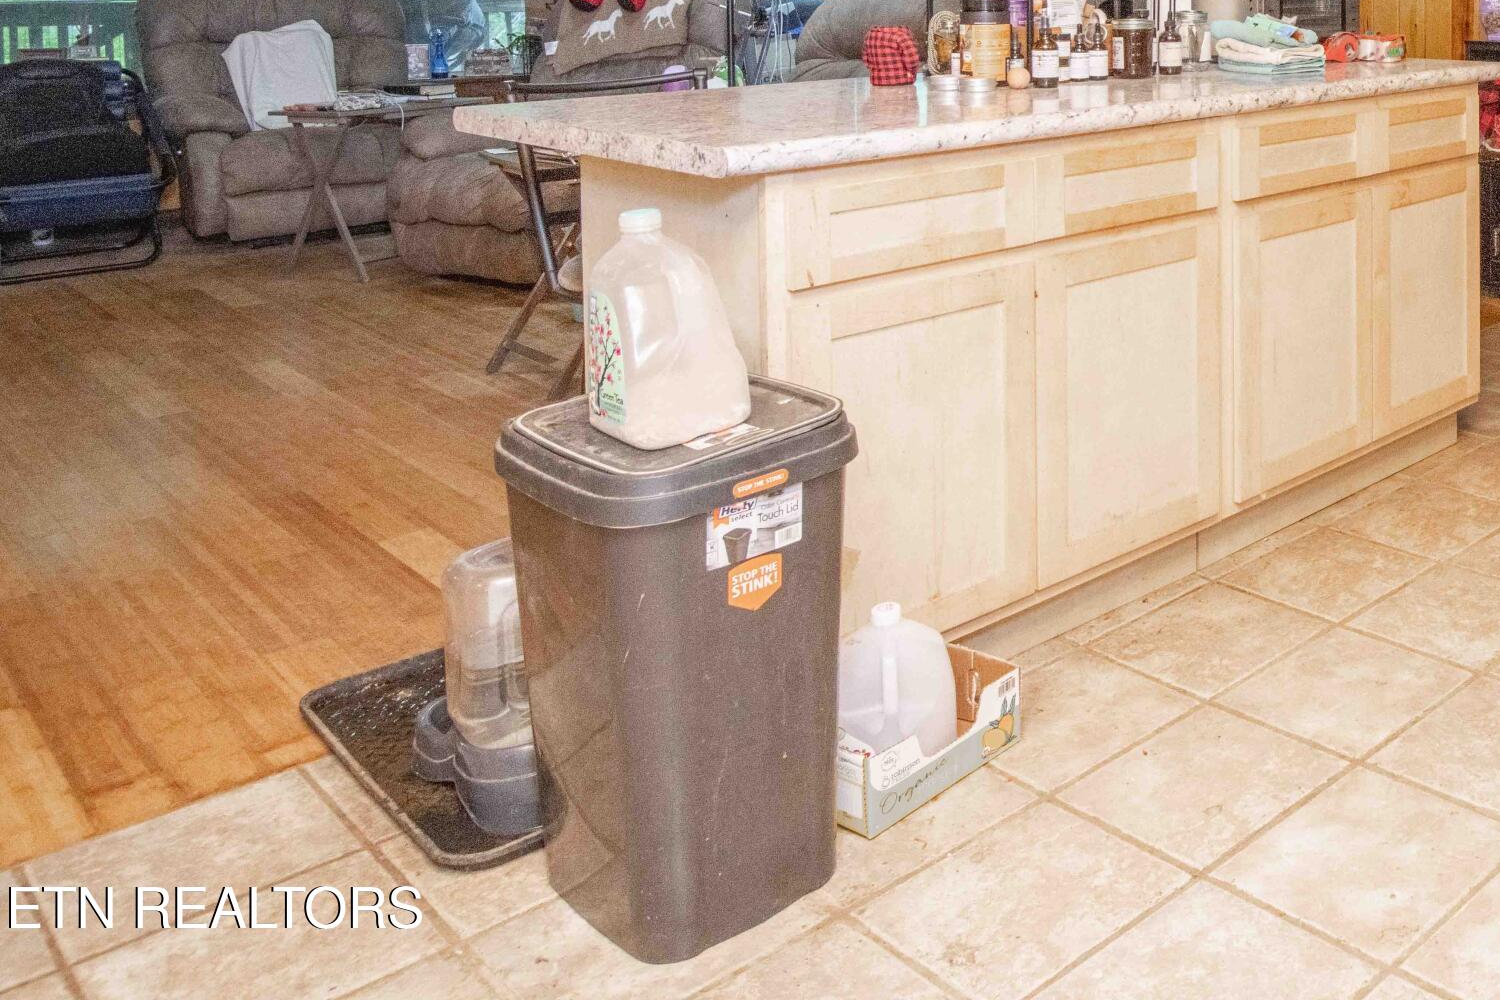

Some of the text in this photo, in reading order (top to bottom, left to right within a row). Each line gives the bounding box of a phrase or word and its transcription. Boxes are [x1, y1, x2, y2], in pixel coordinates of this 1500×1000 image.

[758, 509, 784, 523] Touch
[786, 500, 799, 514] Lid
[731, 560, 778, 586] STOP THE
[731, 571, 778, 600] STINK!
[879, 757, 948, 815] Organic
